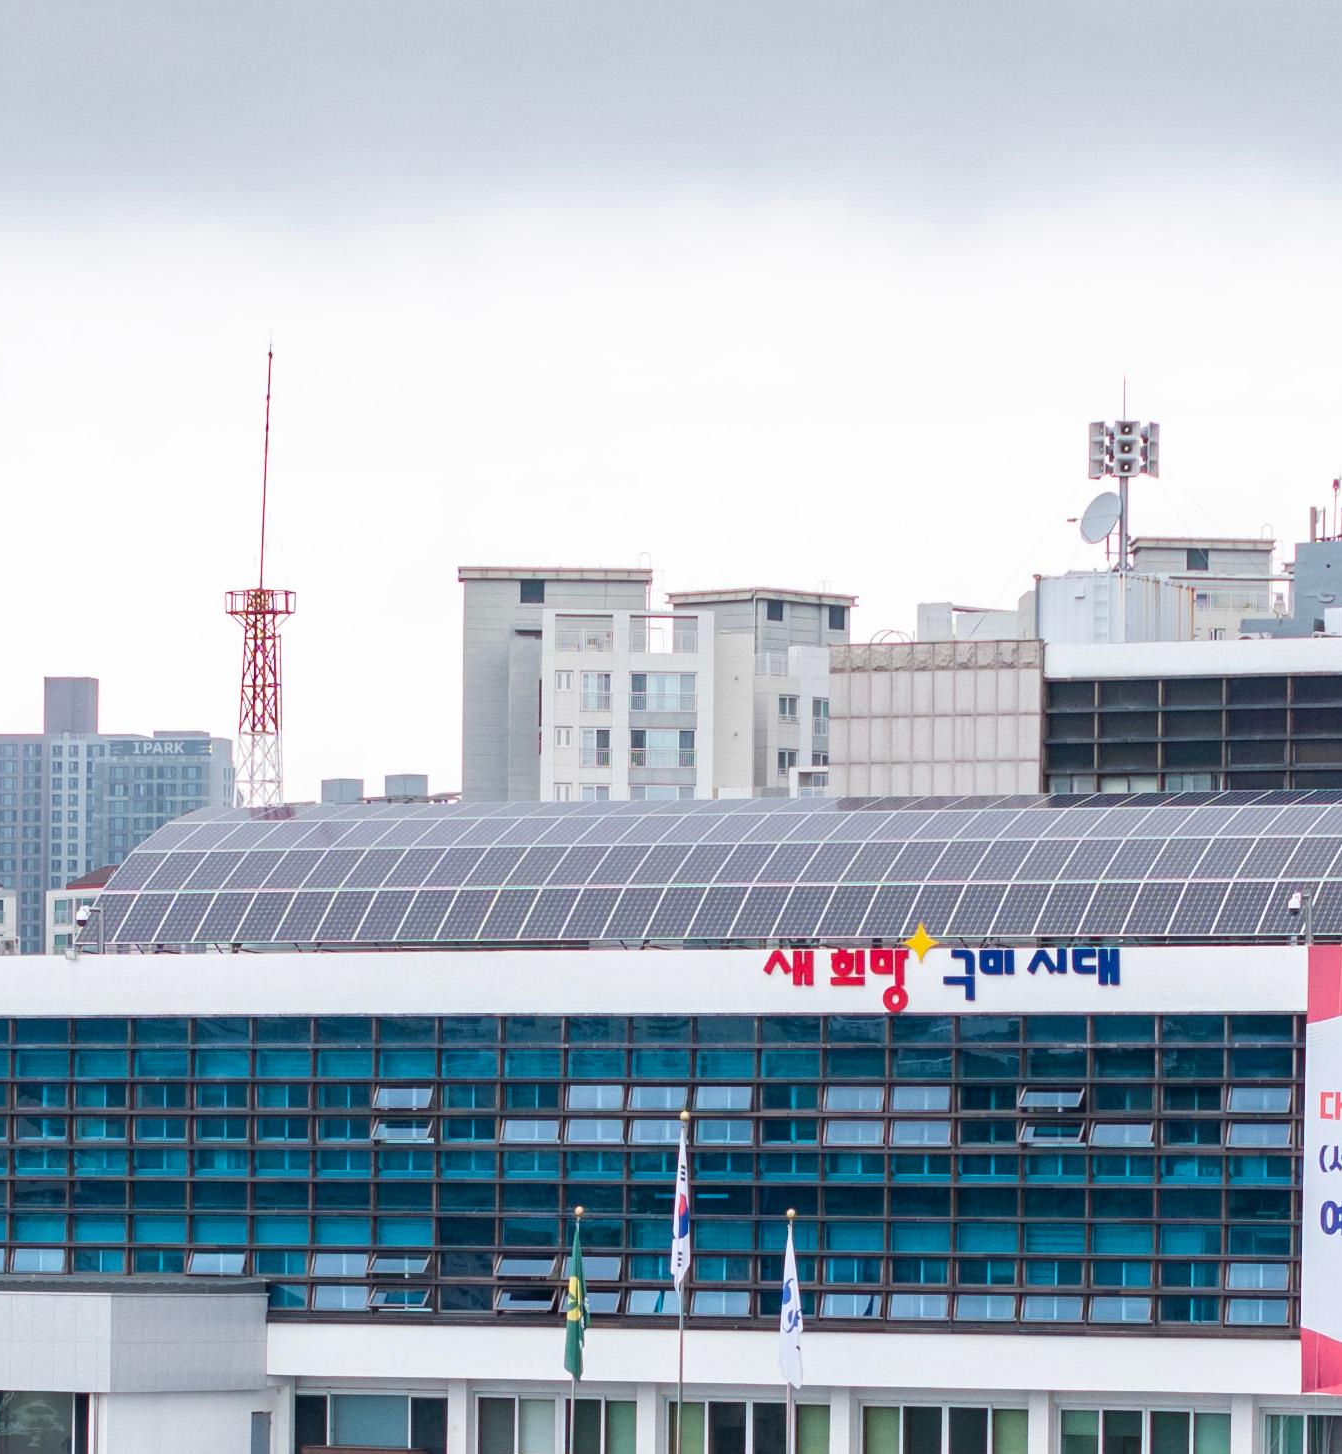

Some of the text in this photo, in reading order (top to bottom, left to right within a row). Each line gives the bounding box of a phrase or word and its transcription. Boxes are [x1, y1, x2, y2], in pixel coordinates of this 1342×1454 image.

[764, 948, 1121, 1013] 새 희망 구미 시대
